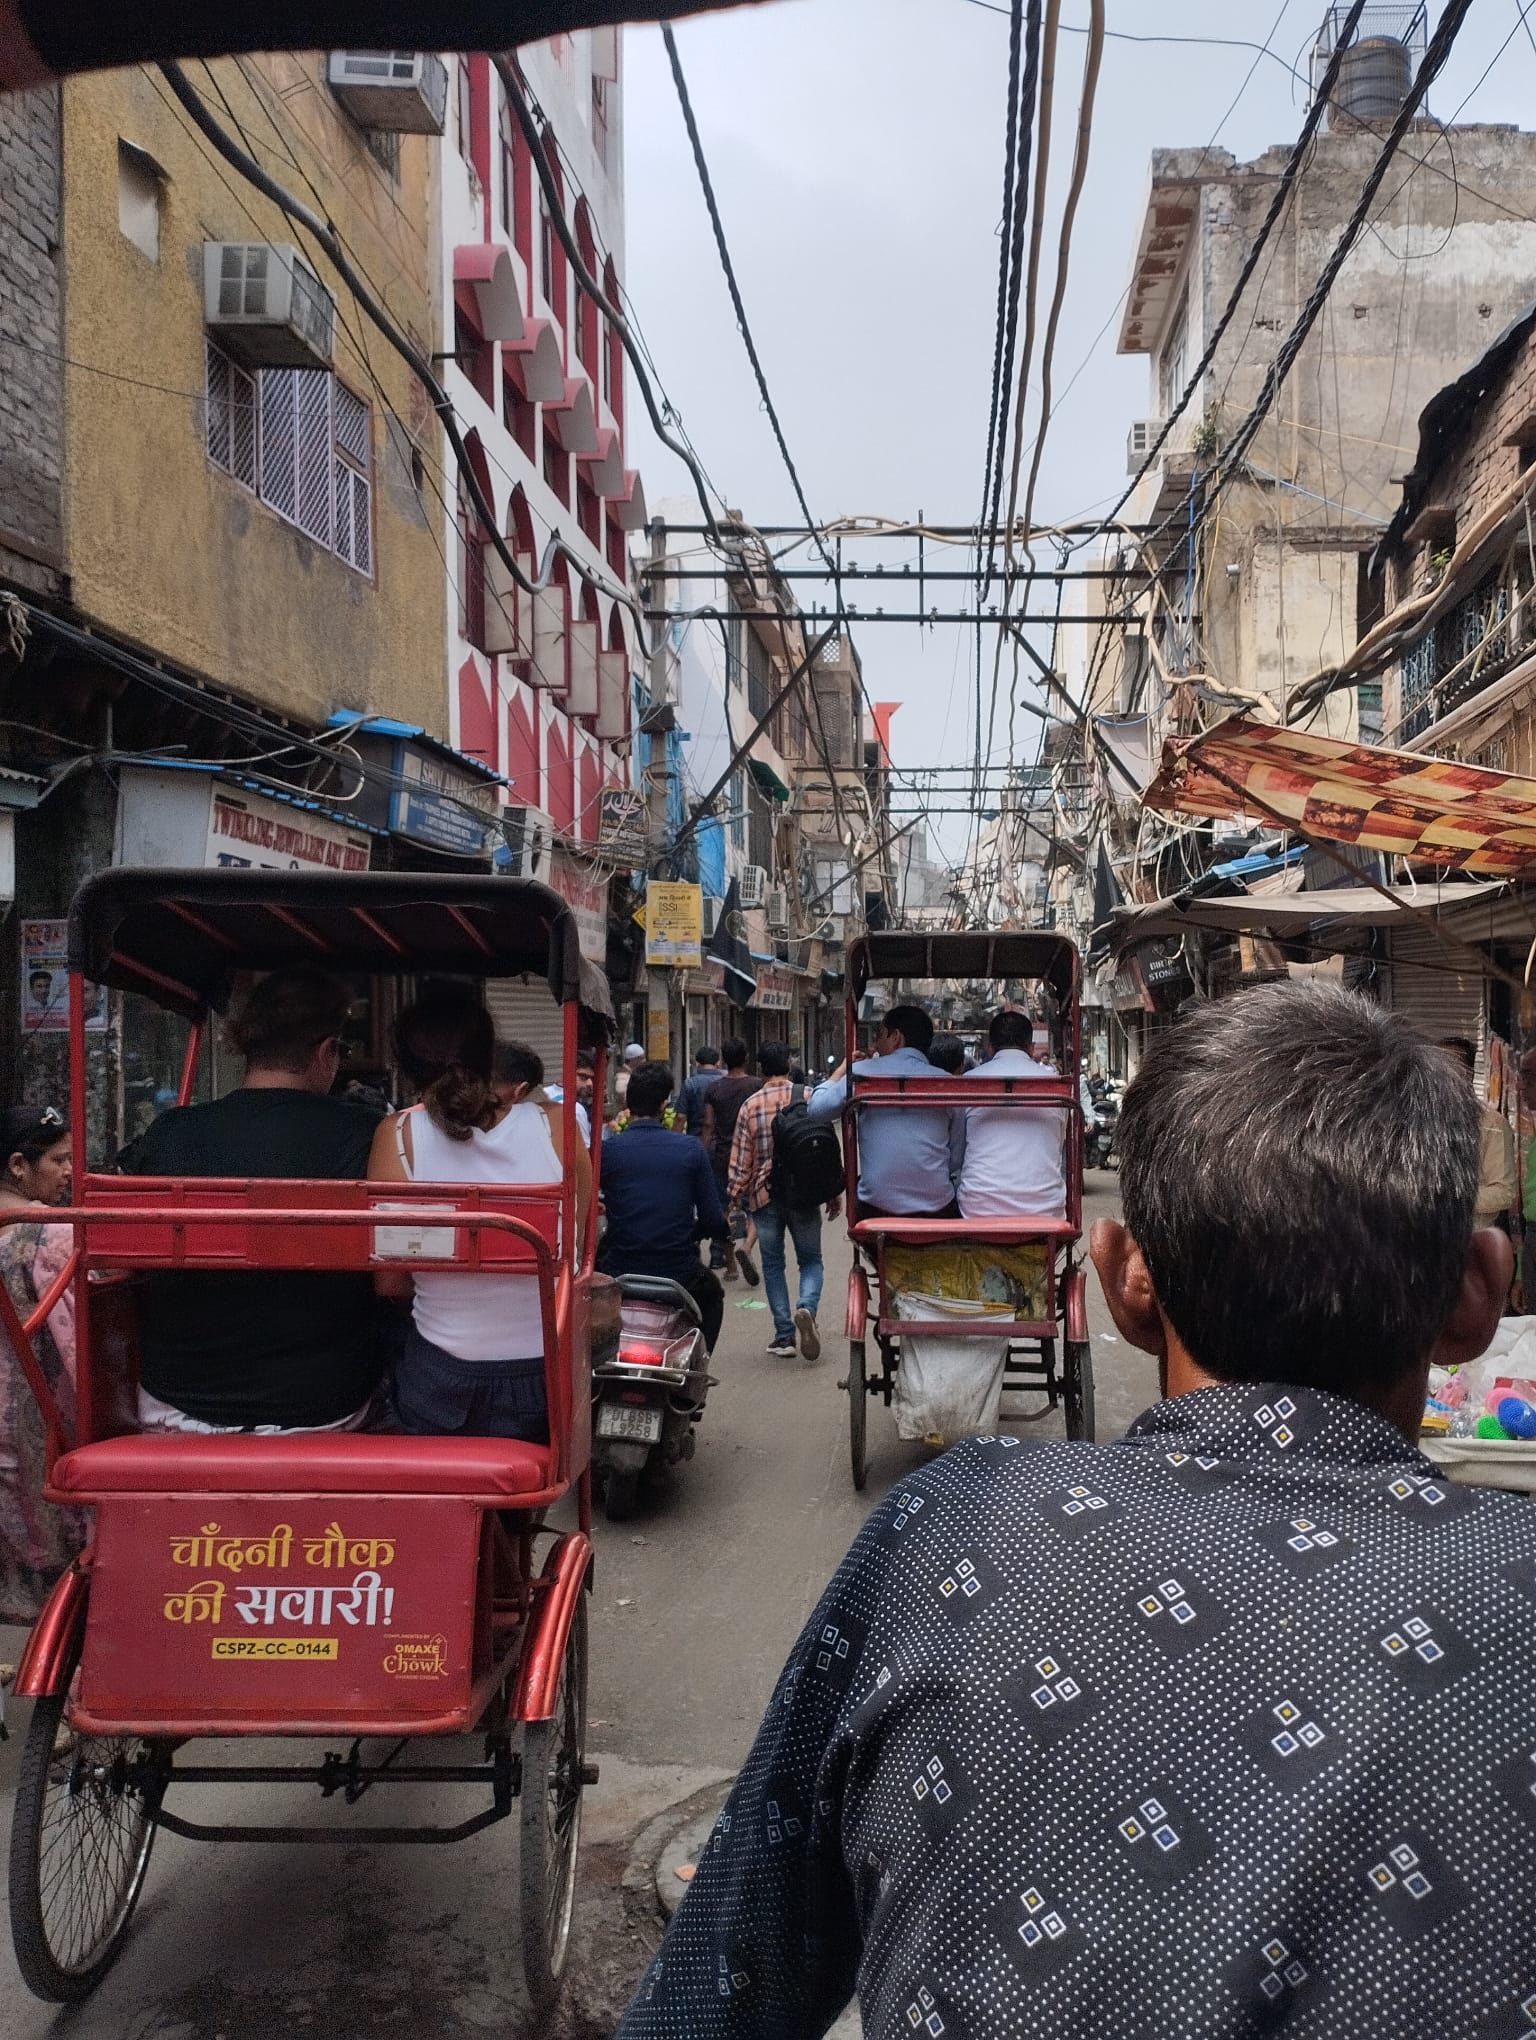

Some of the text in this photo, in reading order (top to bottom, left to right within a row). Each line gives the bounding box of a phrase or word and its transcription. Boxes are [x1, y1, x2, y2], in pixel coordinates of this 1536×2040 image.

[169, 1521, 396, 1572] चाँदनी चौक
[163, 1570, 395, 1626] की सवारी!
[216, 1642, 331, 1655] CSPZ-CC-0144
[395, 1644, 440, 1653] OMAXE
[383, 1653, 449, 1676] Chowk
